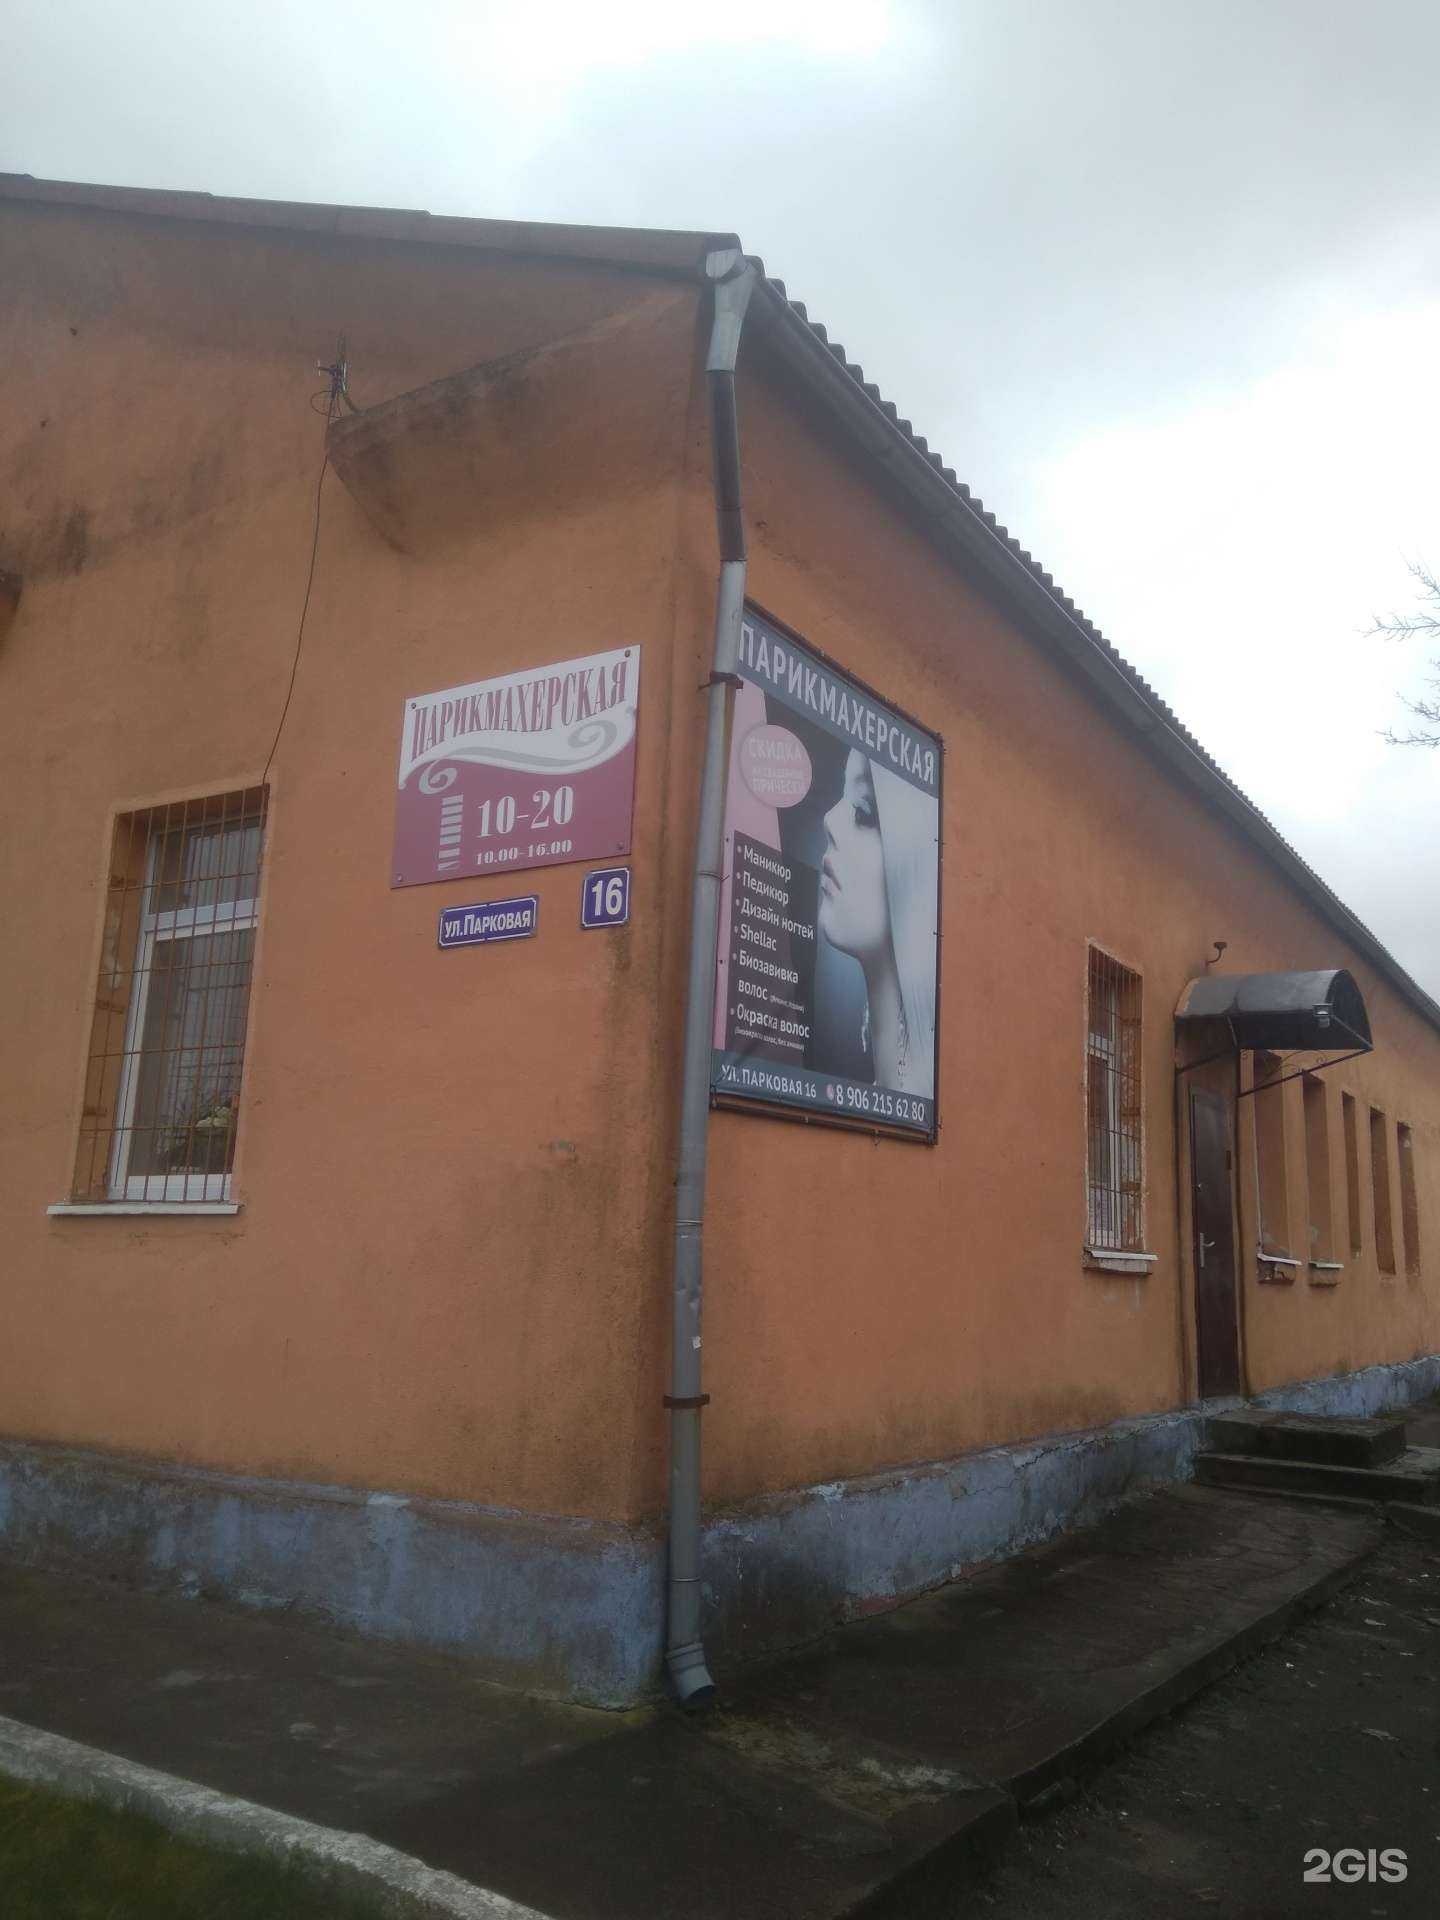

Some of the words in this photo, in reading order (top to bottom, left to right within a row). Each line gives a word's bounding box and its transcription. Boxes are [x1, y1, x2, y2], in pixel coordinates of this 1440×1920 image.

[411, 660, 628, 763] ПАРИКМАХЕРСКАЯ
[738, 622, 934, 785] ПАРИКМАХЕРСКАЯ
[476, 785, 575, 839] 10-20
[744, 845, 791, 883] Маникюр
[591, 877, 623, 917] 16
[743, 870, 789, 907] Педикюр
[740, 923, 777, 951] Shellac
[741, 897, 780, 926] Дизайн
[781, 917, 814, 940] ногтей
[739, 949, 799, 984] Биозавивка
[738, 979, 768, 1001] волос
[737, 1003, 778, 1030] Окраска
[780, 1020, 810, 1039] волос
[721, 1064, 740, 1083] УЛ.
[742, 1068, 803, 1096] ПАРКОВАЯ
[804, 1082, 817, 1098] 16
[836, 1084, 844, 1105] 8
[846, 1086, 870, 1110] 906
[872, 1092, 893, 1115] 215
[896, 1098, 909, 1118] 62
[911, 1101, 925, 1122] 80
